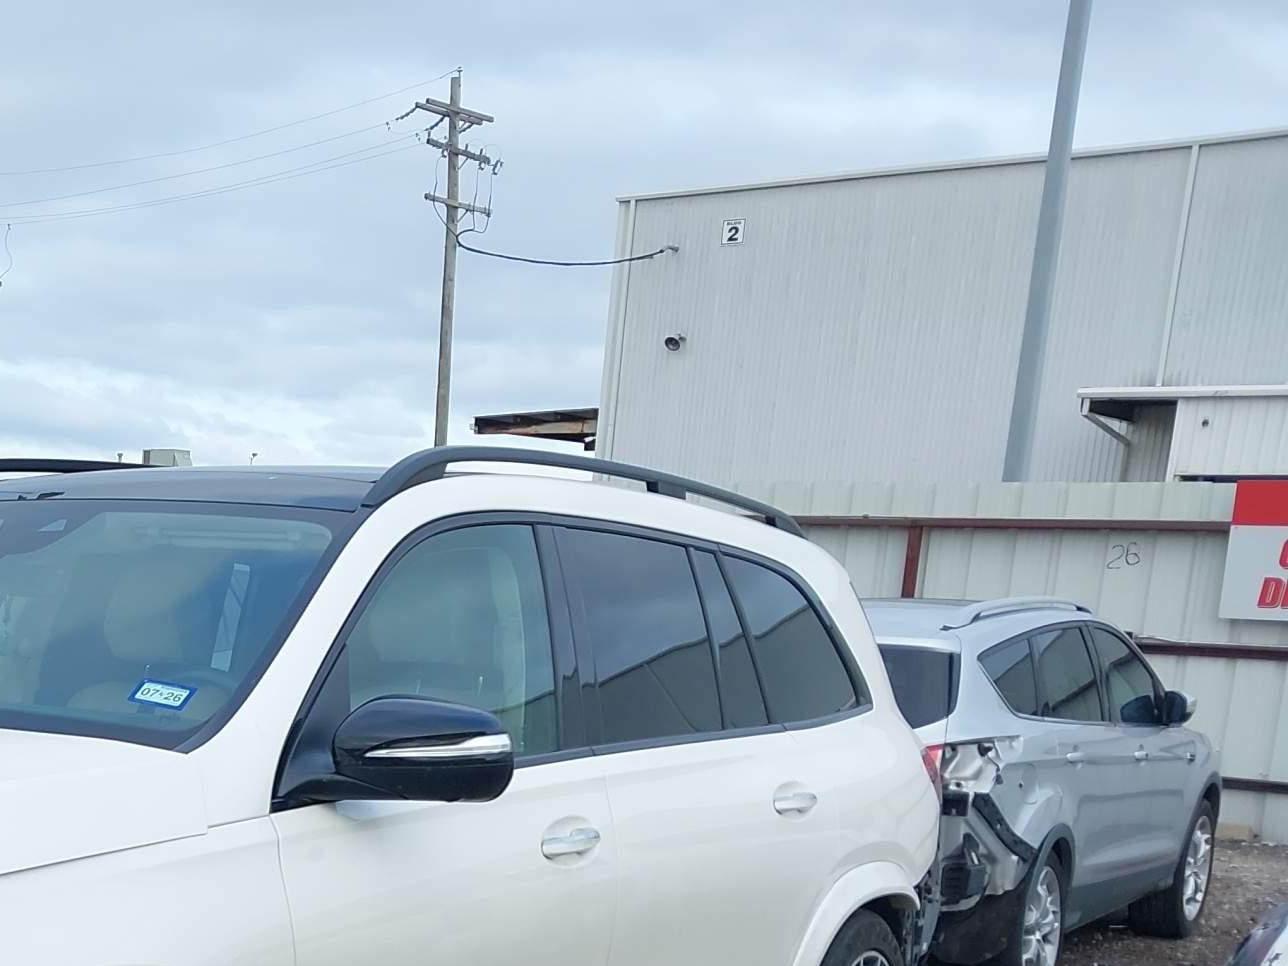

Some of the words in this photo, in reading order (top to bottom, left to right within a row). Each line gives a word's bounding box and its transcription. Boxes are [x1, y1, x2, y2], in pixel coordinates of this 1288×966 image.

[727, 226, 739, 242] 2
[1107, 541, 1141, 570] 26
[140, 687, 161, 697] 07
[163, 691, 183, 702] 26
